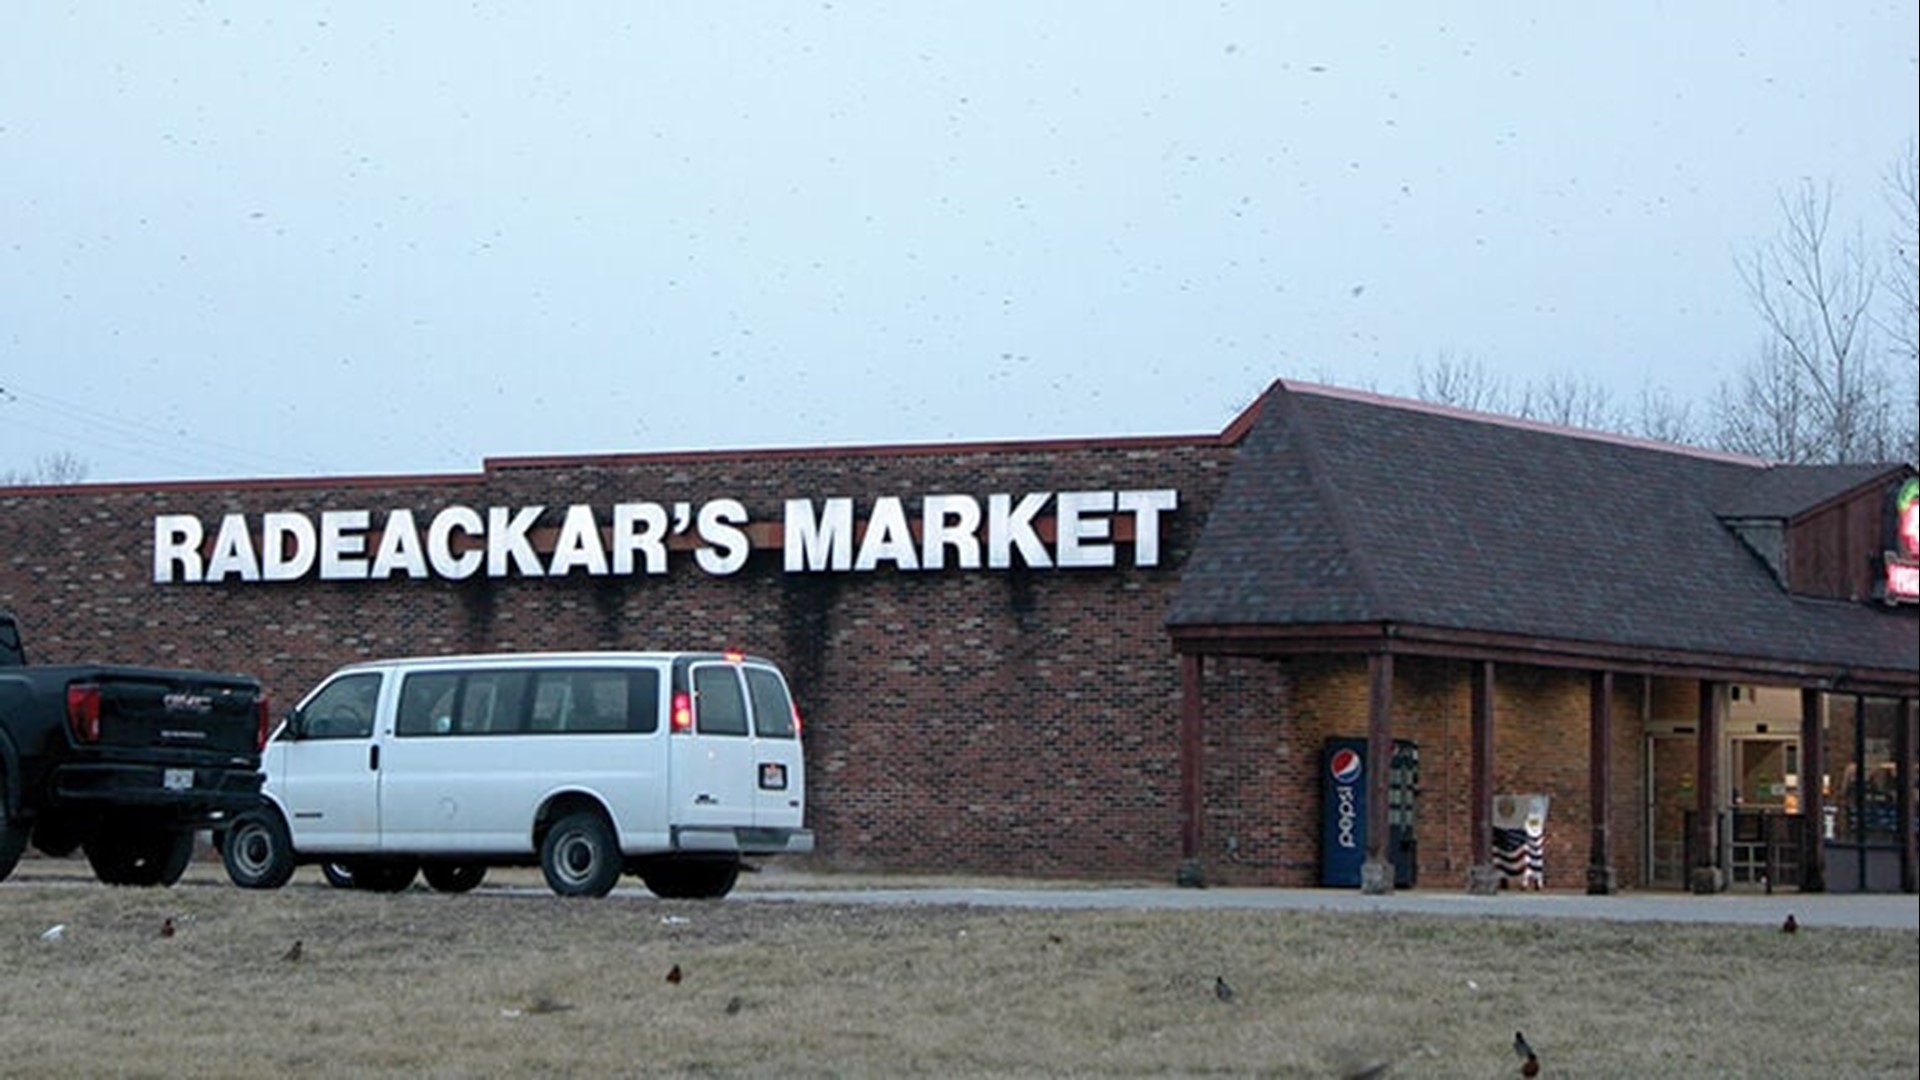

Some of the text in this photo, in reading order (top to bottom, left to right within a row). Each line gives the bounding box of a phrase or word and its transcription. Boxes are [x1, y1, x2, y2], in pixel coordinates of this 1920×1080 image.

[154, 489, 1178, 583] RADEACKAR'S MARKET
[1337, 786, 1356, 848] pepsi
